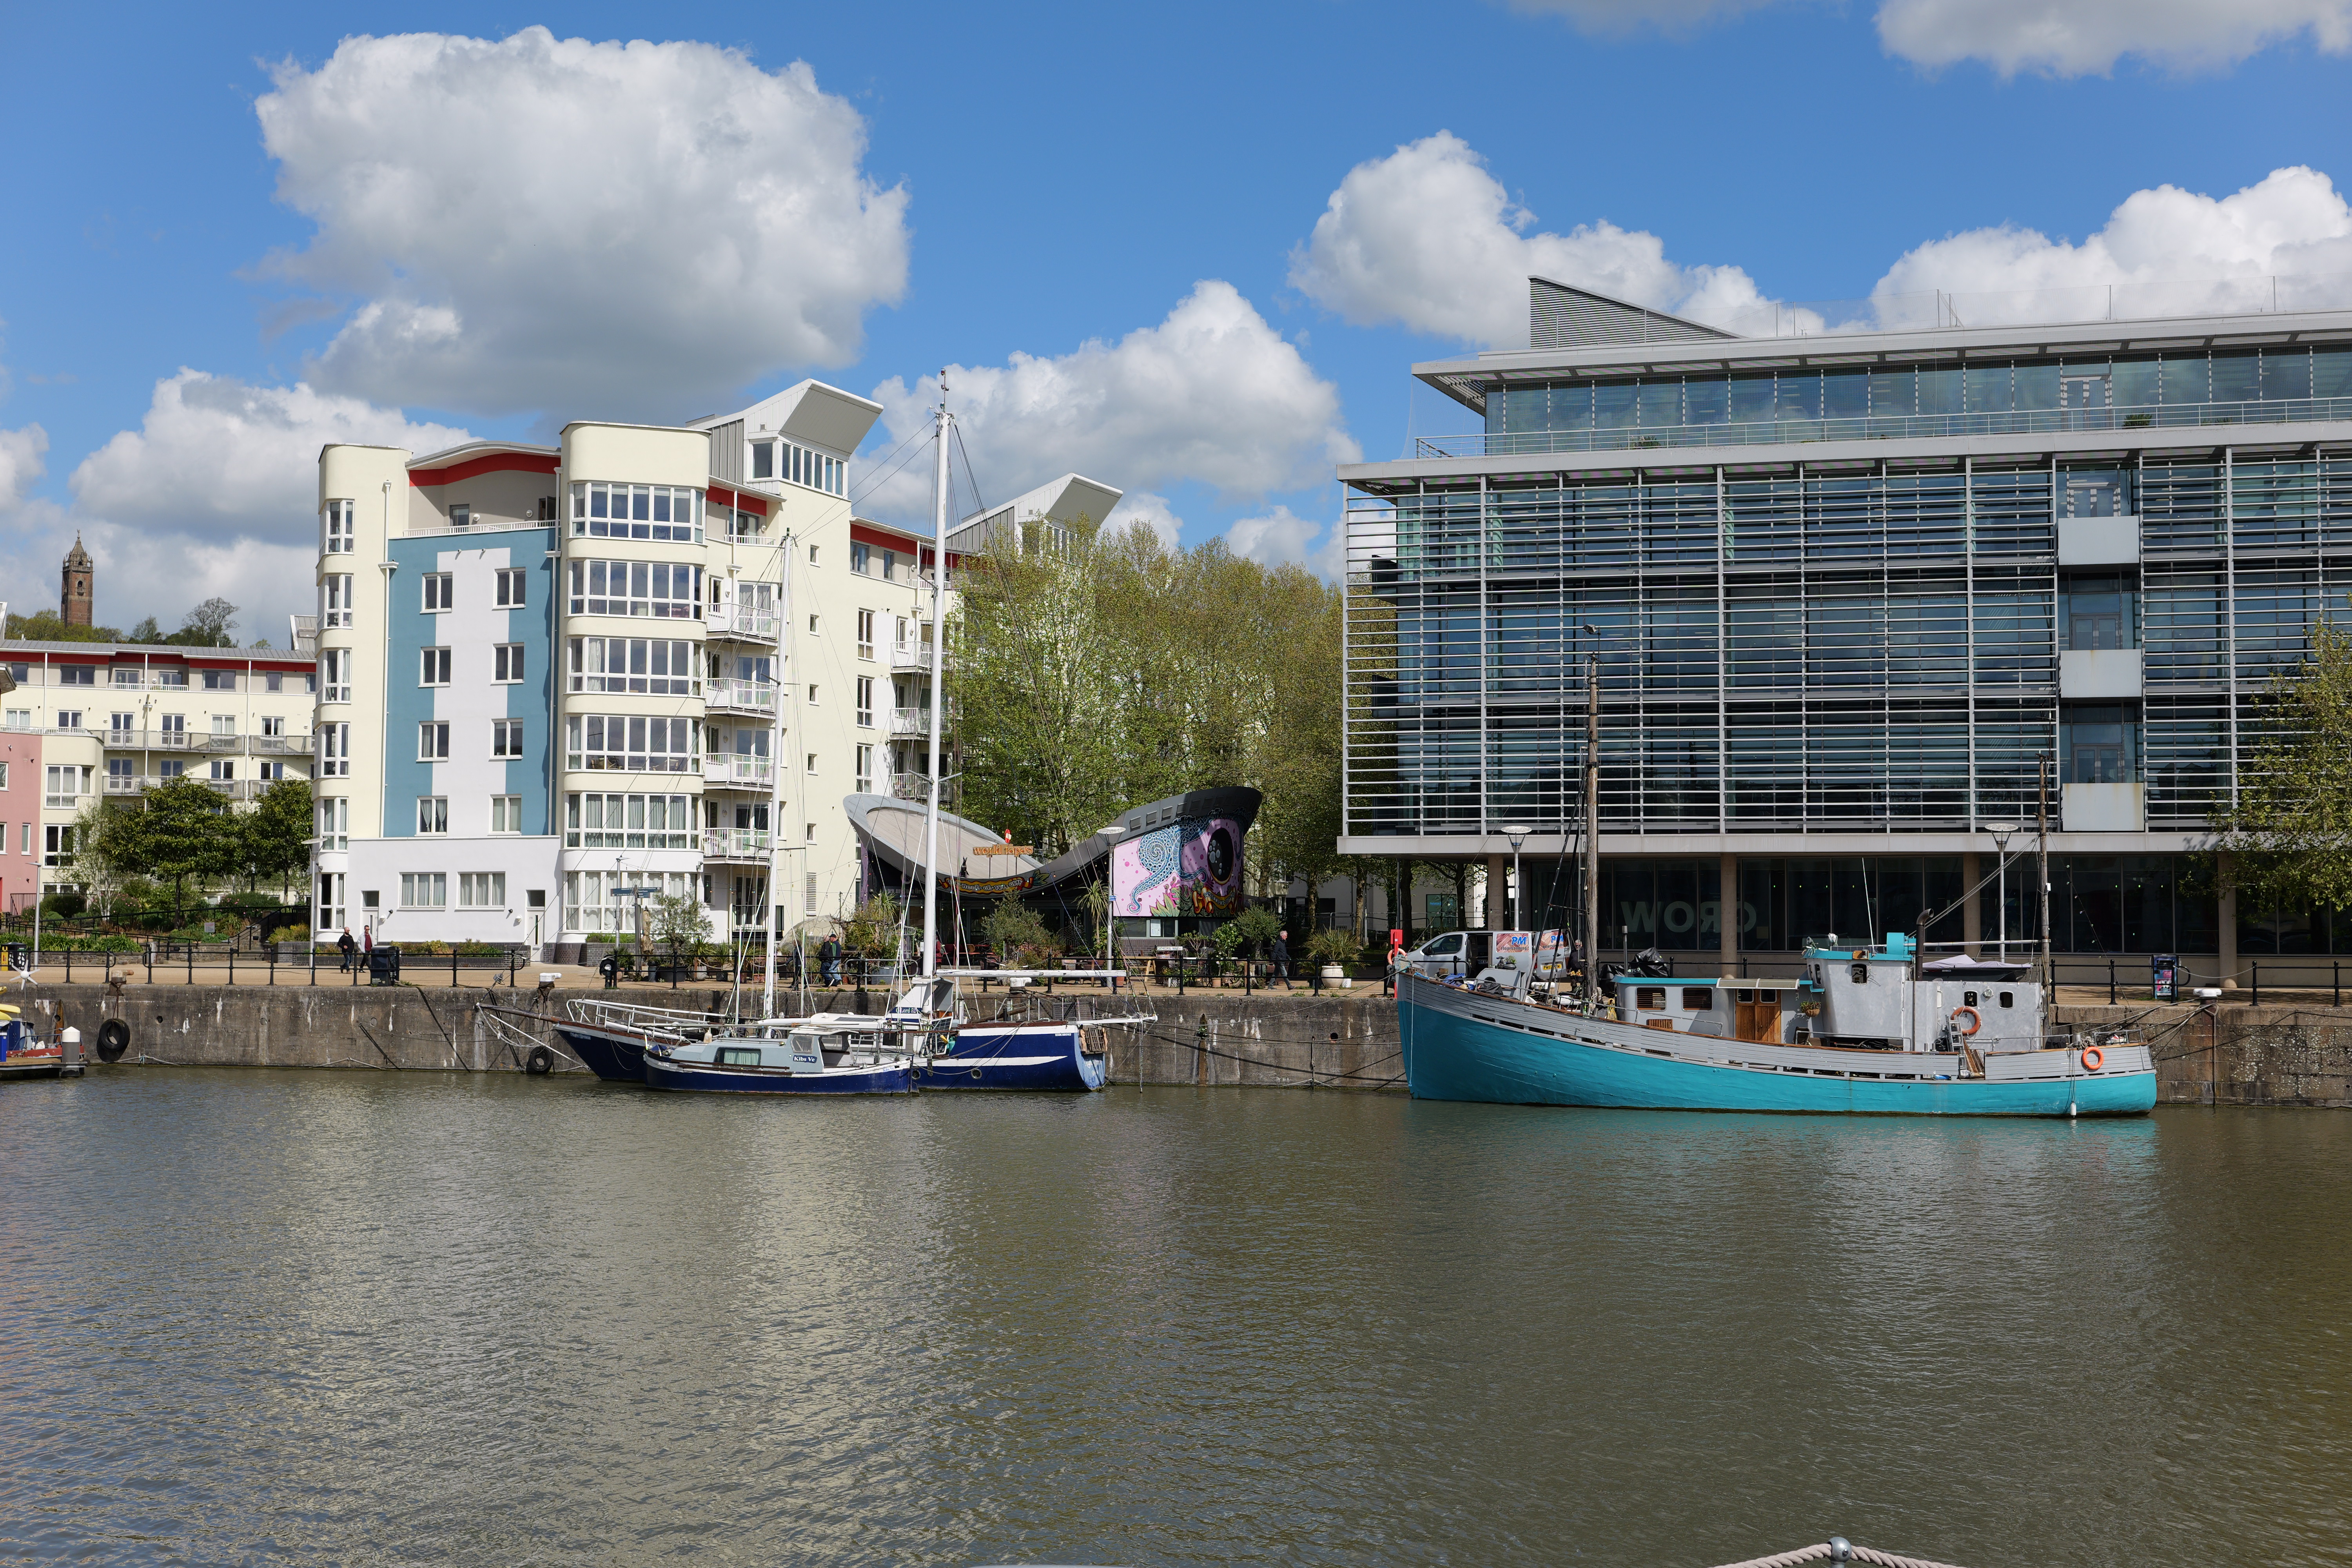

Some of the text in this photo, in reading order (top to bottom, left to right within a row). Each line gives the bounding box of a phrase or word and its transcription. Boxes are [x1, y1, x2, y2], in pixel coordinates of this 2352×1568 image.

[973, 844, 1033, 857] world tapas
[1511, 936, 1527, 946] PM
